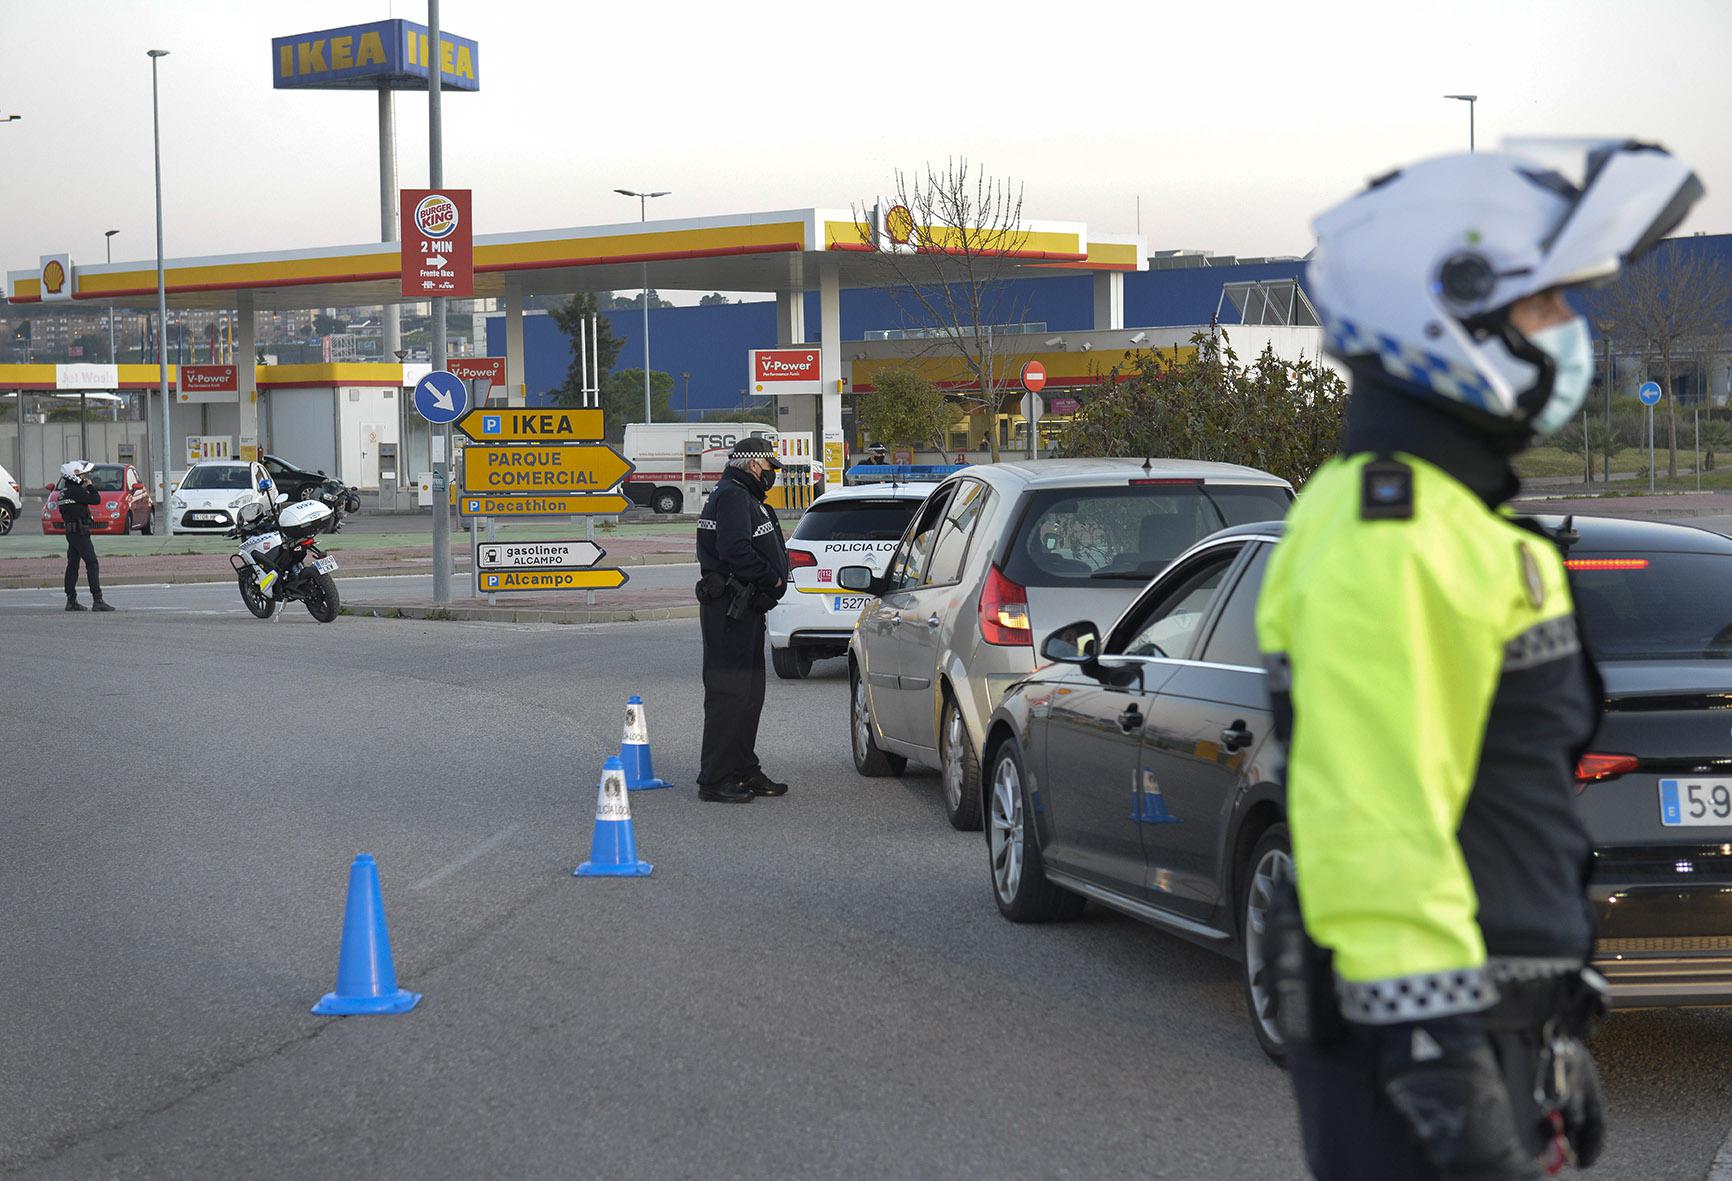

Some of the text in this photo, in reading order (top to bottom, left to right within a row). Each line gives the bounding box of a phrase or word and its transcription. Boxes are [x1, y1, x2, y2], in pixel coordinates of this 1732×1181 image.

[280, 31, 387, 78] IKEA
[420, 203, 452, 218] BURGER
[421, 211, 453, 229] KING
[421, 241, 453, 253] 2 MIN
[452, 367, 497, 377] V-Power
[762, 361, 811, 371] V-Power
[187, 373, 230, 384] V-Power
[512, 415, 573, 434] IKEA
[696, 434, 736, 449] TSG
[488, 452, 562, 467] PARQUE
[488, 470, 598, 486] COMERCIAL
[485, 499, 567, 512] Decathlon
[506, 545, 569, 558] gasolinera
[824, 543, 874, 553] POLICIA
[513, 555, 563, 565] ALCAMPO
[822, 569, 832, 577] 112
[504, 573, 573, 587] Alcampo
[1687, 784, 1731, 819] 59
